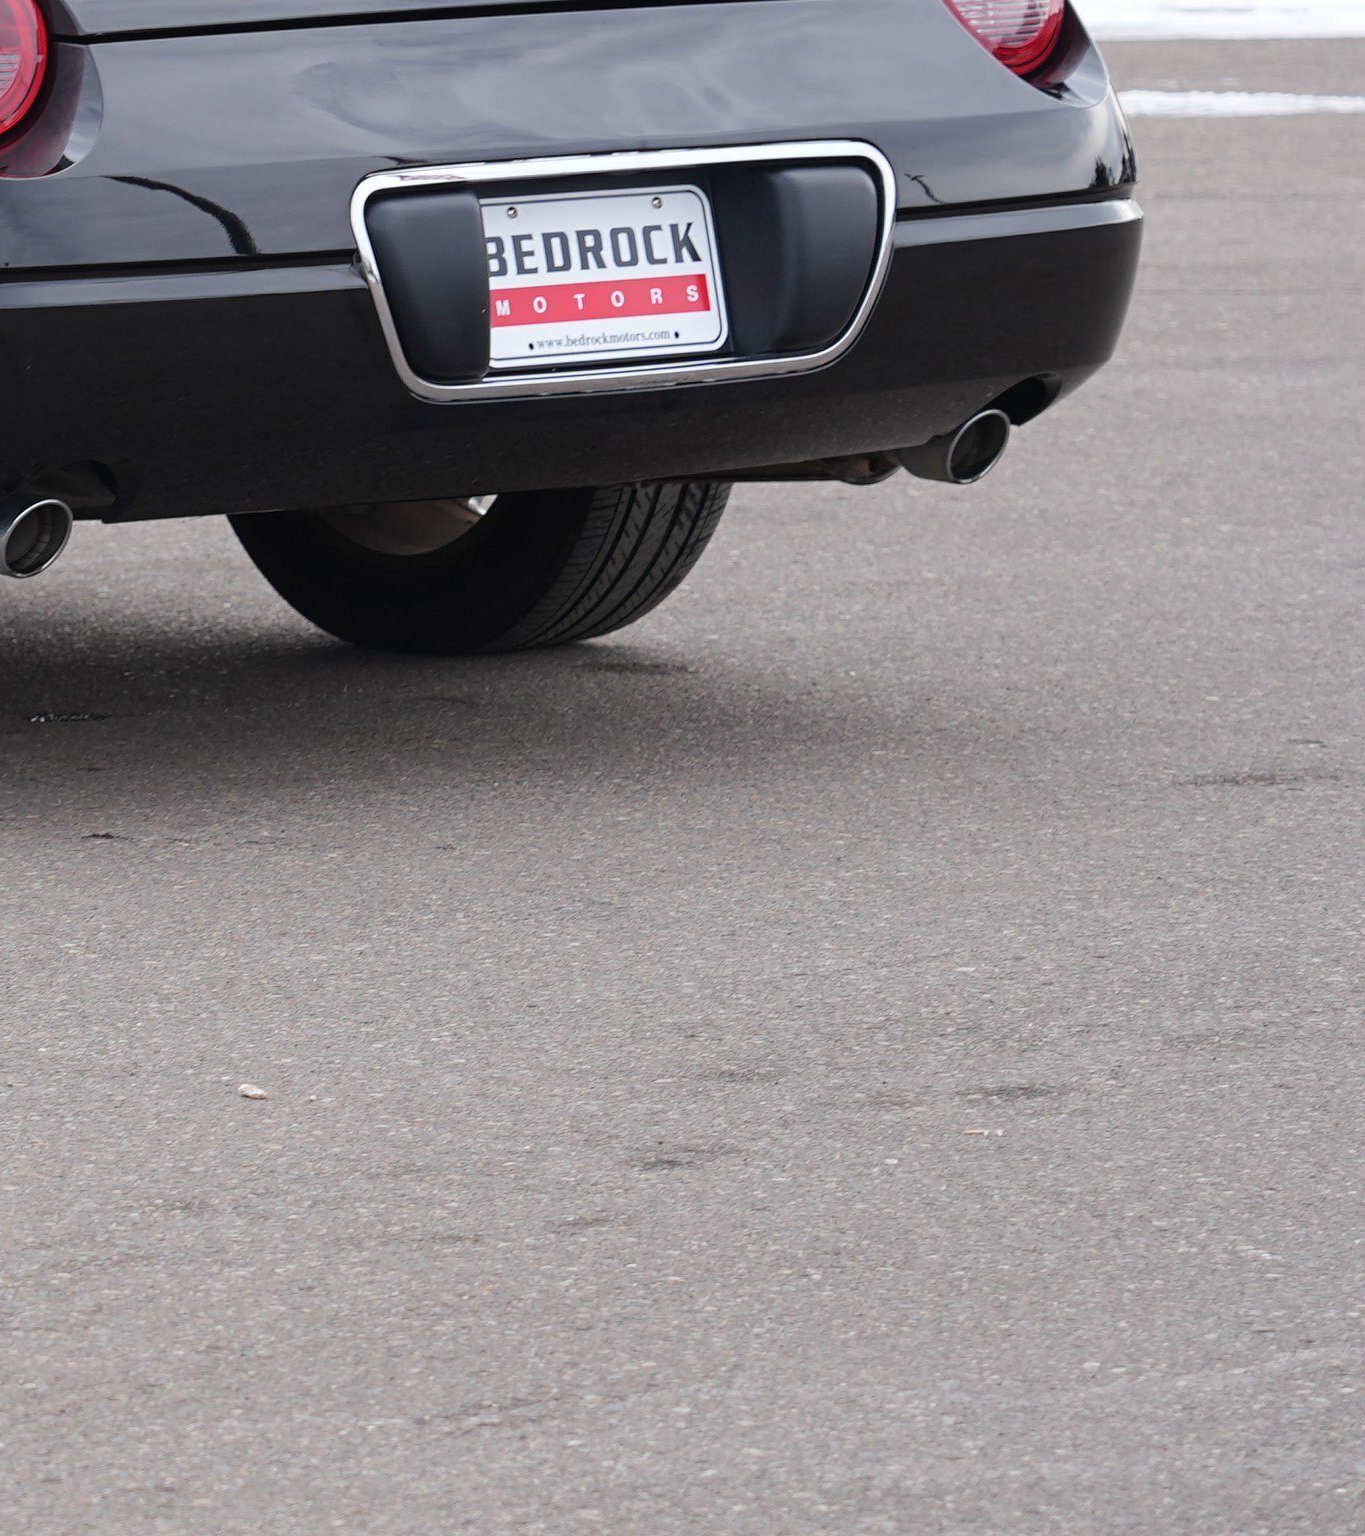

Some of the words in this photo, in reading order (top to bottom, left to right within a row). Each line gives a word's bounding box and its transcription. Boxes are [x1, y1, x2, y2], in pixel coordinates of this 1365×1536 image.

[485, 221, 703, 277] BEDROCK
[495, 284, 701, 317] MOTORS
[536, 329, 671, 350] www.bedrockmotors.com
